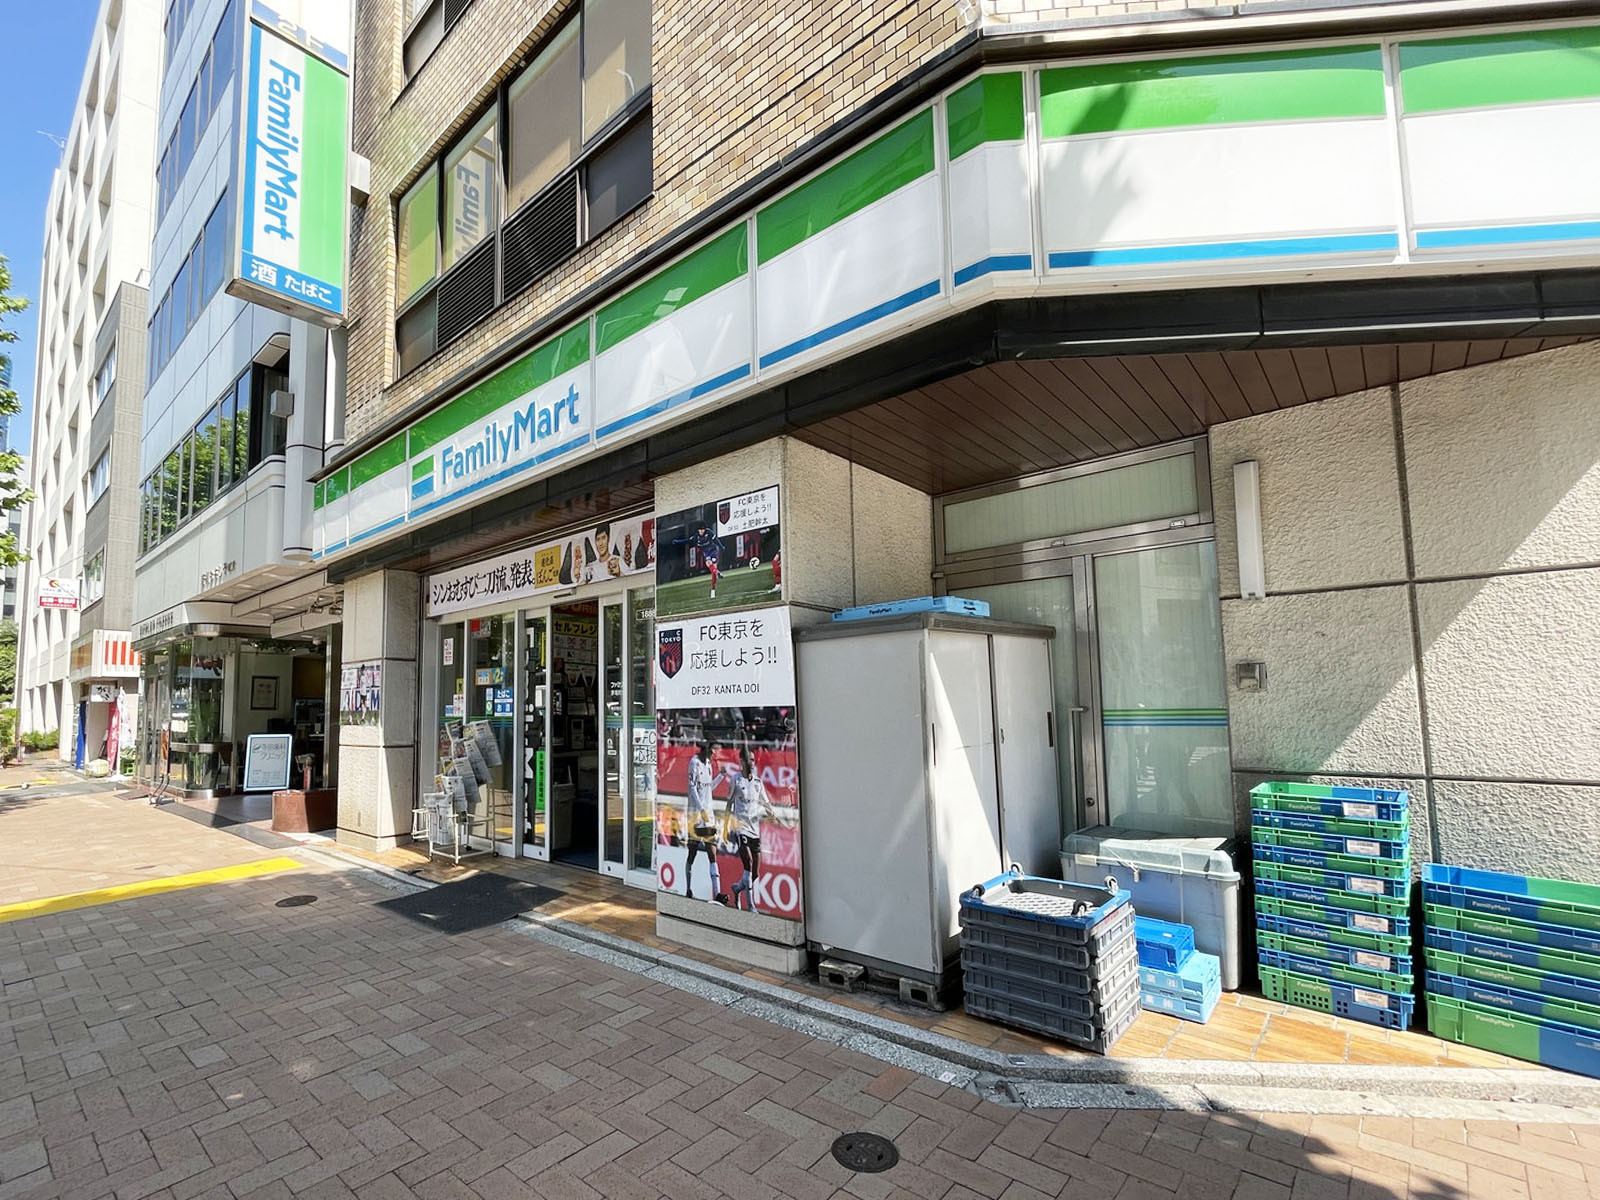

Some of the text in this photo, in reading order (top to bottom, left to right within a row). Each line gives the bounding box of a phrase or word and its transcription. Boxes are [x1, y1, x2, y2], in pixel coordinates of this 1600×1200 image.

[264, 58, 300, 242] FamilyMart
[250, 259, 333, 305] 酒 たばこ
[441, 383, 580, 485] FamilyMart
[738, 492, 767, 507] FC東京を
[869, 607, 893, 615] FamilyMart
[699, 619, 764, 642] FC東京を
[690, 646, 777, 670] 応援しよう!!
[691, 683, 760, 696] DF32 KANTA DOI
[1288, 803, 1322, 811] FamilyMart
[1290, 857, 1323, 866] FamilyMart
[753, 871, 800, 912] KO
[1292, 892, 1326, 902] FamilyMart
[1471, 900, 1512, 912] FamilyMart
[1294, 928, 1328, 938] FamilyMart
[1473, 922, 1513, 934] FamilyMart
[1473, 947, 1513, 959] FamilyMart
[1475, 969, 1514, 981] FamilyMart
[1296, 981, 1331, 992] FamilyMart
[1473, 991, 1513, 1005] FamilyMart
[1475, 1014, 1515, 1028] FamilyMart
